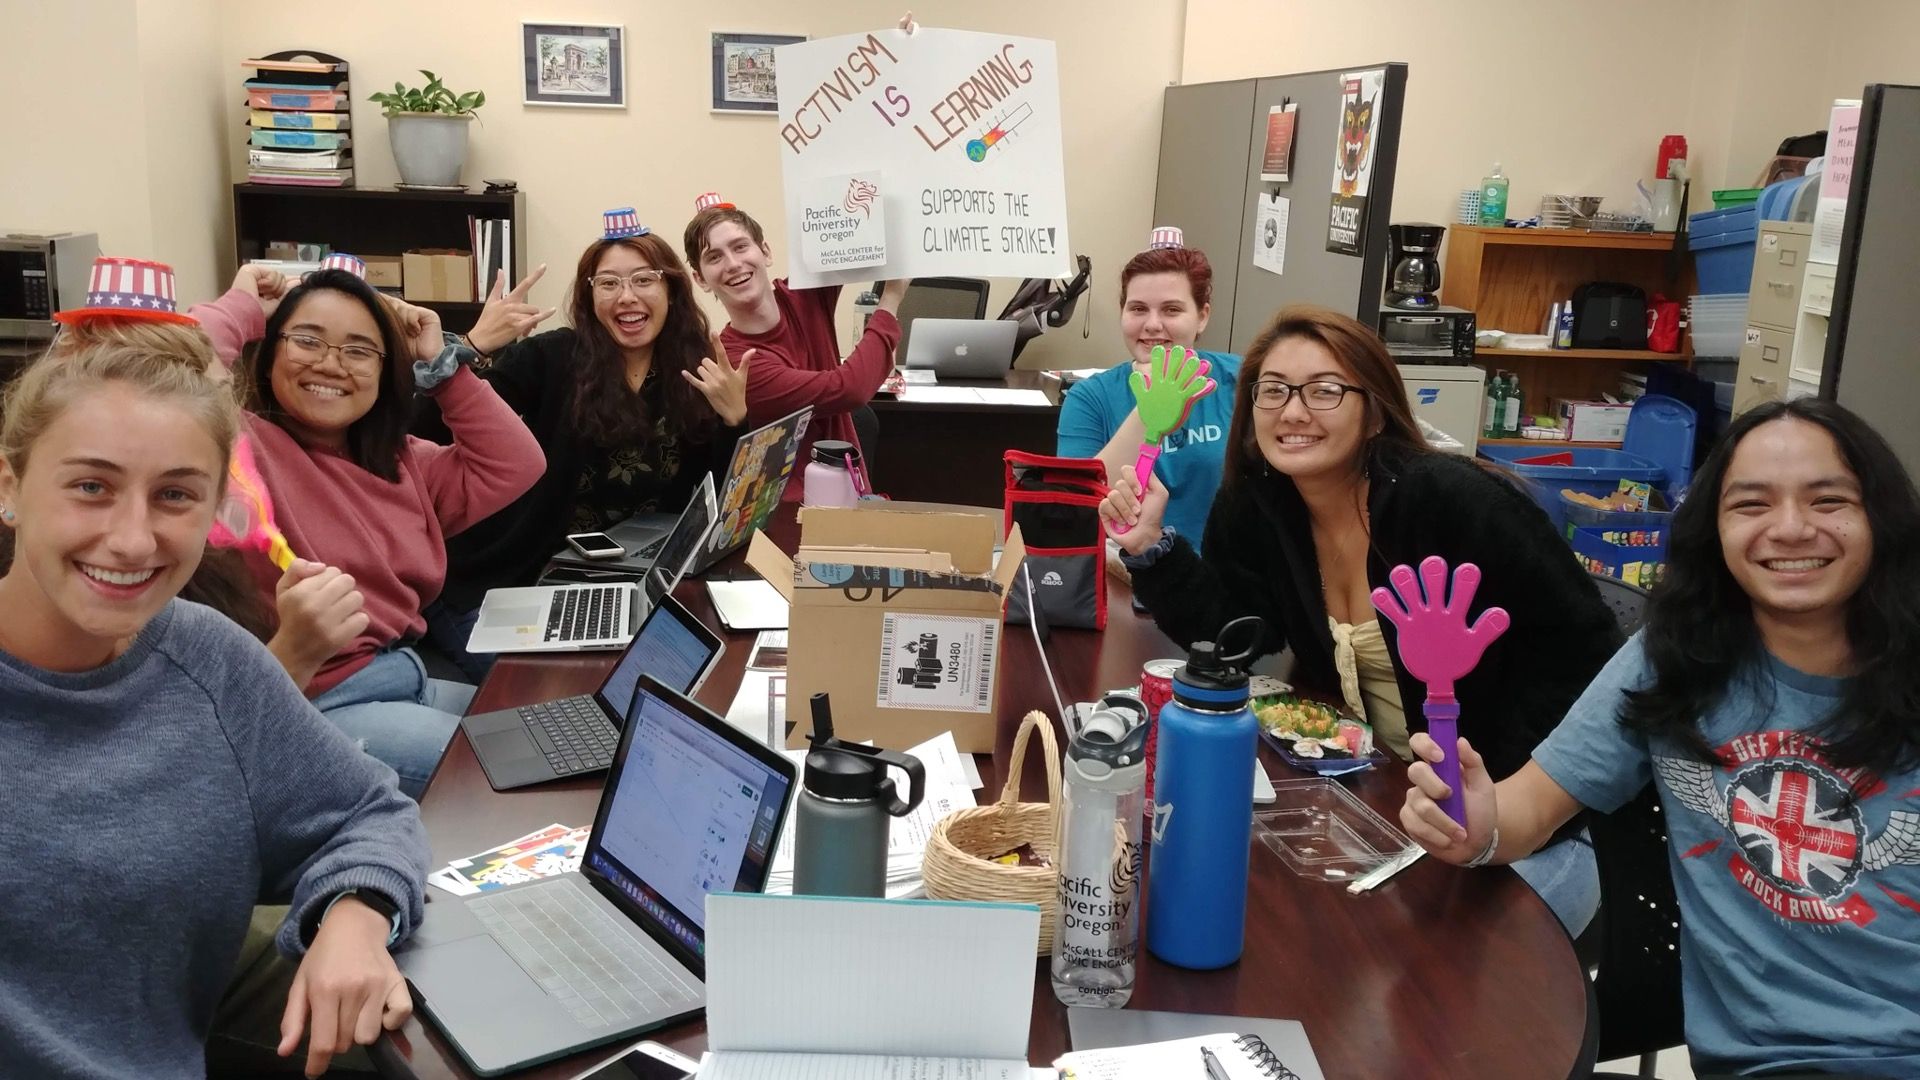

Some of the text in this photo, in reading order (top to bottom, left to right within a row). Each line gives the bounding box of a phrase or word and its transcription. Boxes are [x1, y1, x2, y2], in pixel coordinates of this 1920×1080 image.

[781, 33, 899, 155] ACTIVISM
[871, 85, 911, 127] IS
[913, 43, 1034, 152] LEARNING
[805, 206, 841, 220] Pacific
[921, 188, 1030, 217] SUPPORTS THE
[802, 217, 861, 233] University
[1331, 205, 1360, 230] PACIFIC
[819, 229, 854, 243] Oregon
[922, 226, 1056, 255] CLIMATE STRIKE!
[1329, 227, 1356, 246] UNIVERSITY
[820, 249, 847, 257] McCALL
[847, 247, 873, 255] CENTER
[821, 253, 884, 265] CIVIC ENGAGEMENT
[947, 642, 961, 683] UN3480
[1731, 732, 1769, 763] DEF
[1059, 874, 1102, 898] acific
[1743, 870, 1783, 912] ROCK
[1057, 890, 1131, 919] niversity
[1064, 914, 1120, 936] Oregon
[1062, 941, 1105, 958] McCALL
[1062, 951, 1089, 968] CIVIC
[1078, 985, 1116, 996] contigo
